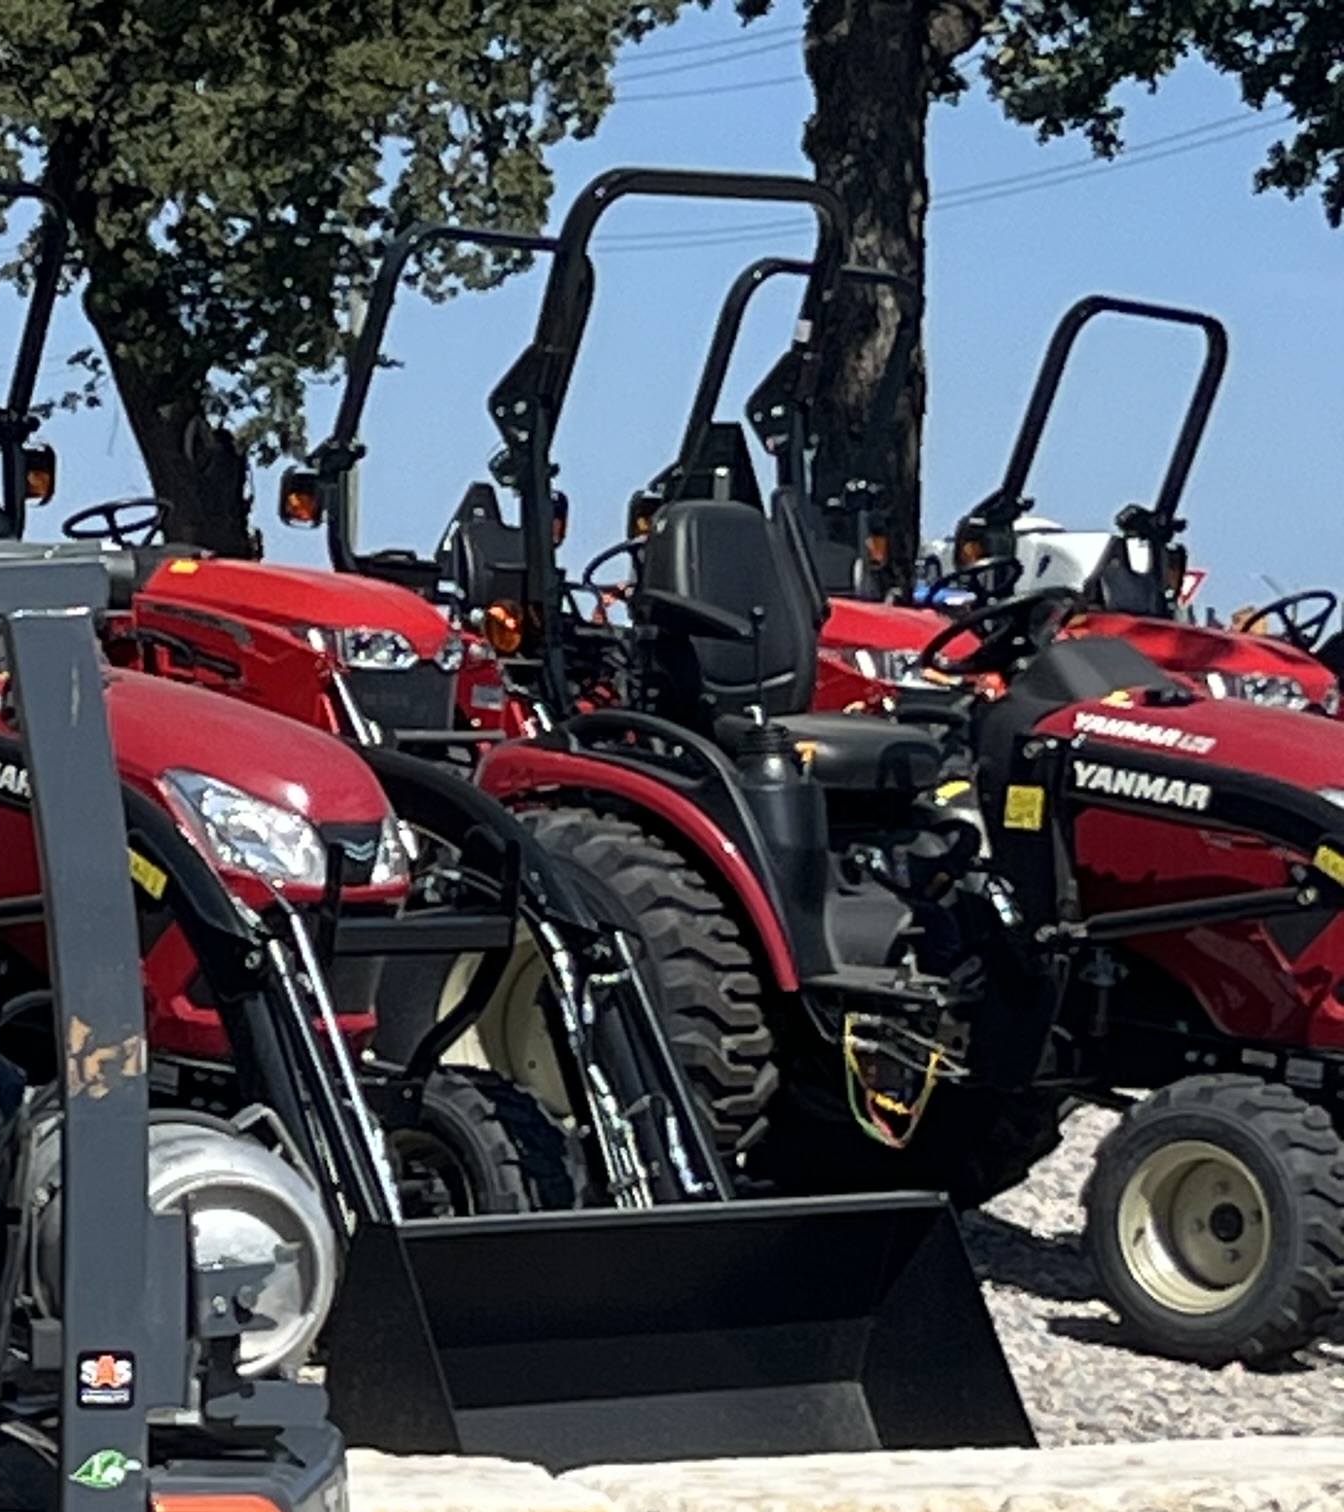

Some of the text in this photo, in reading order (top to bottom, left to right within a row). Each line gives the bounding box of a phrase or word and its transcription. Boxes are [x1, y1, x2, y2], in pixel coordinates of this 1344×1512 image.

[1073, 712, 1182, 747] YANMAR
[1073, 760, 1211, 810] YANMAR
[80, 1355, 132, 1388] SAS
